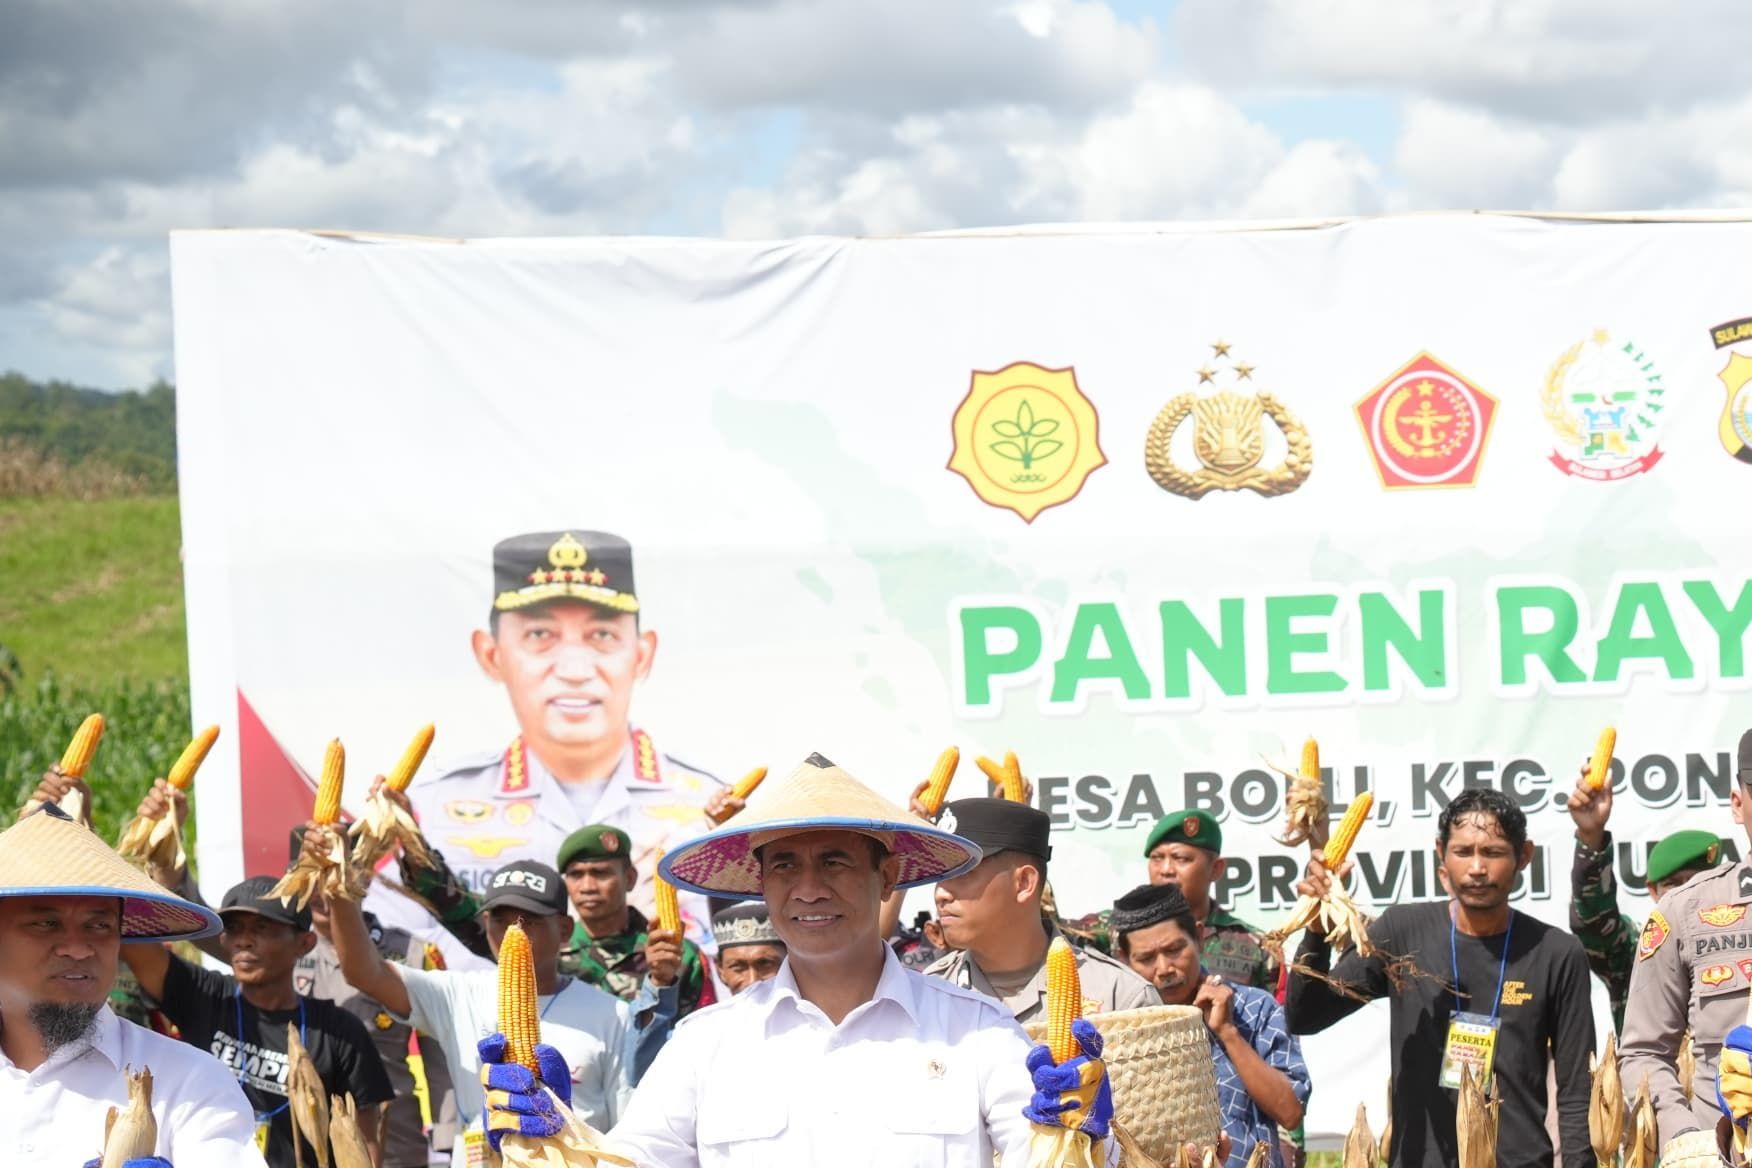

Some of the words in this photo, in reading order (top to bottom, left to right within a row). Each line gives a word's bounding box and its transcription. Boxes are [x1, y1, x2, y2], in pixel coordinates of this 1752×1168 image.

[960, 590, 1446, 705] PANEN
[988, 774, 1165, 825] ESA
[1412, 758, 1568, 810] KEC.
[1450, 1033, 1492, 1048] PESERTA
